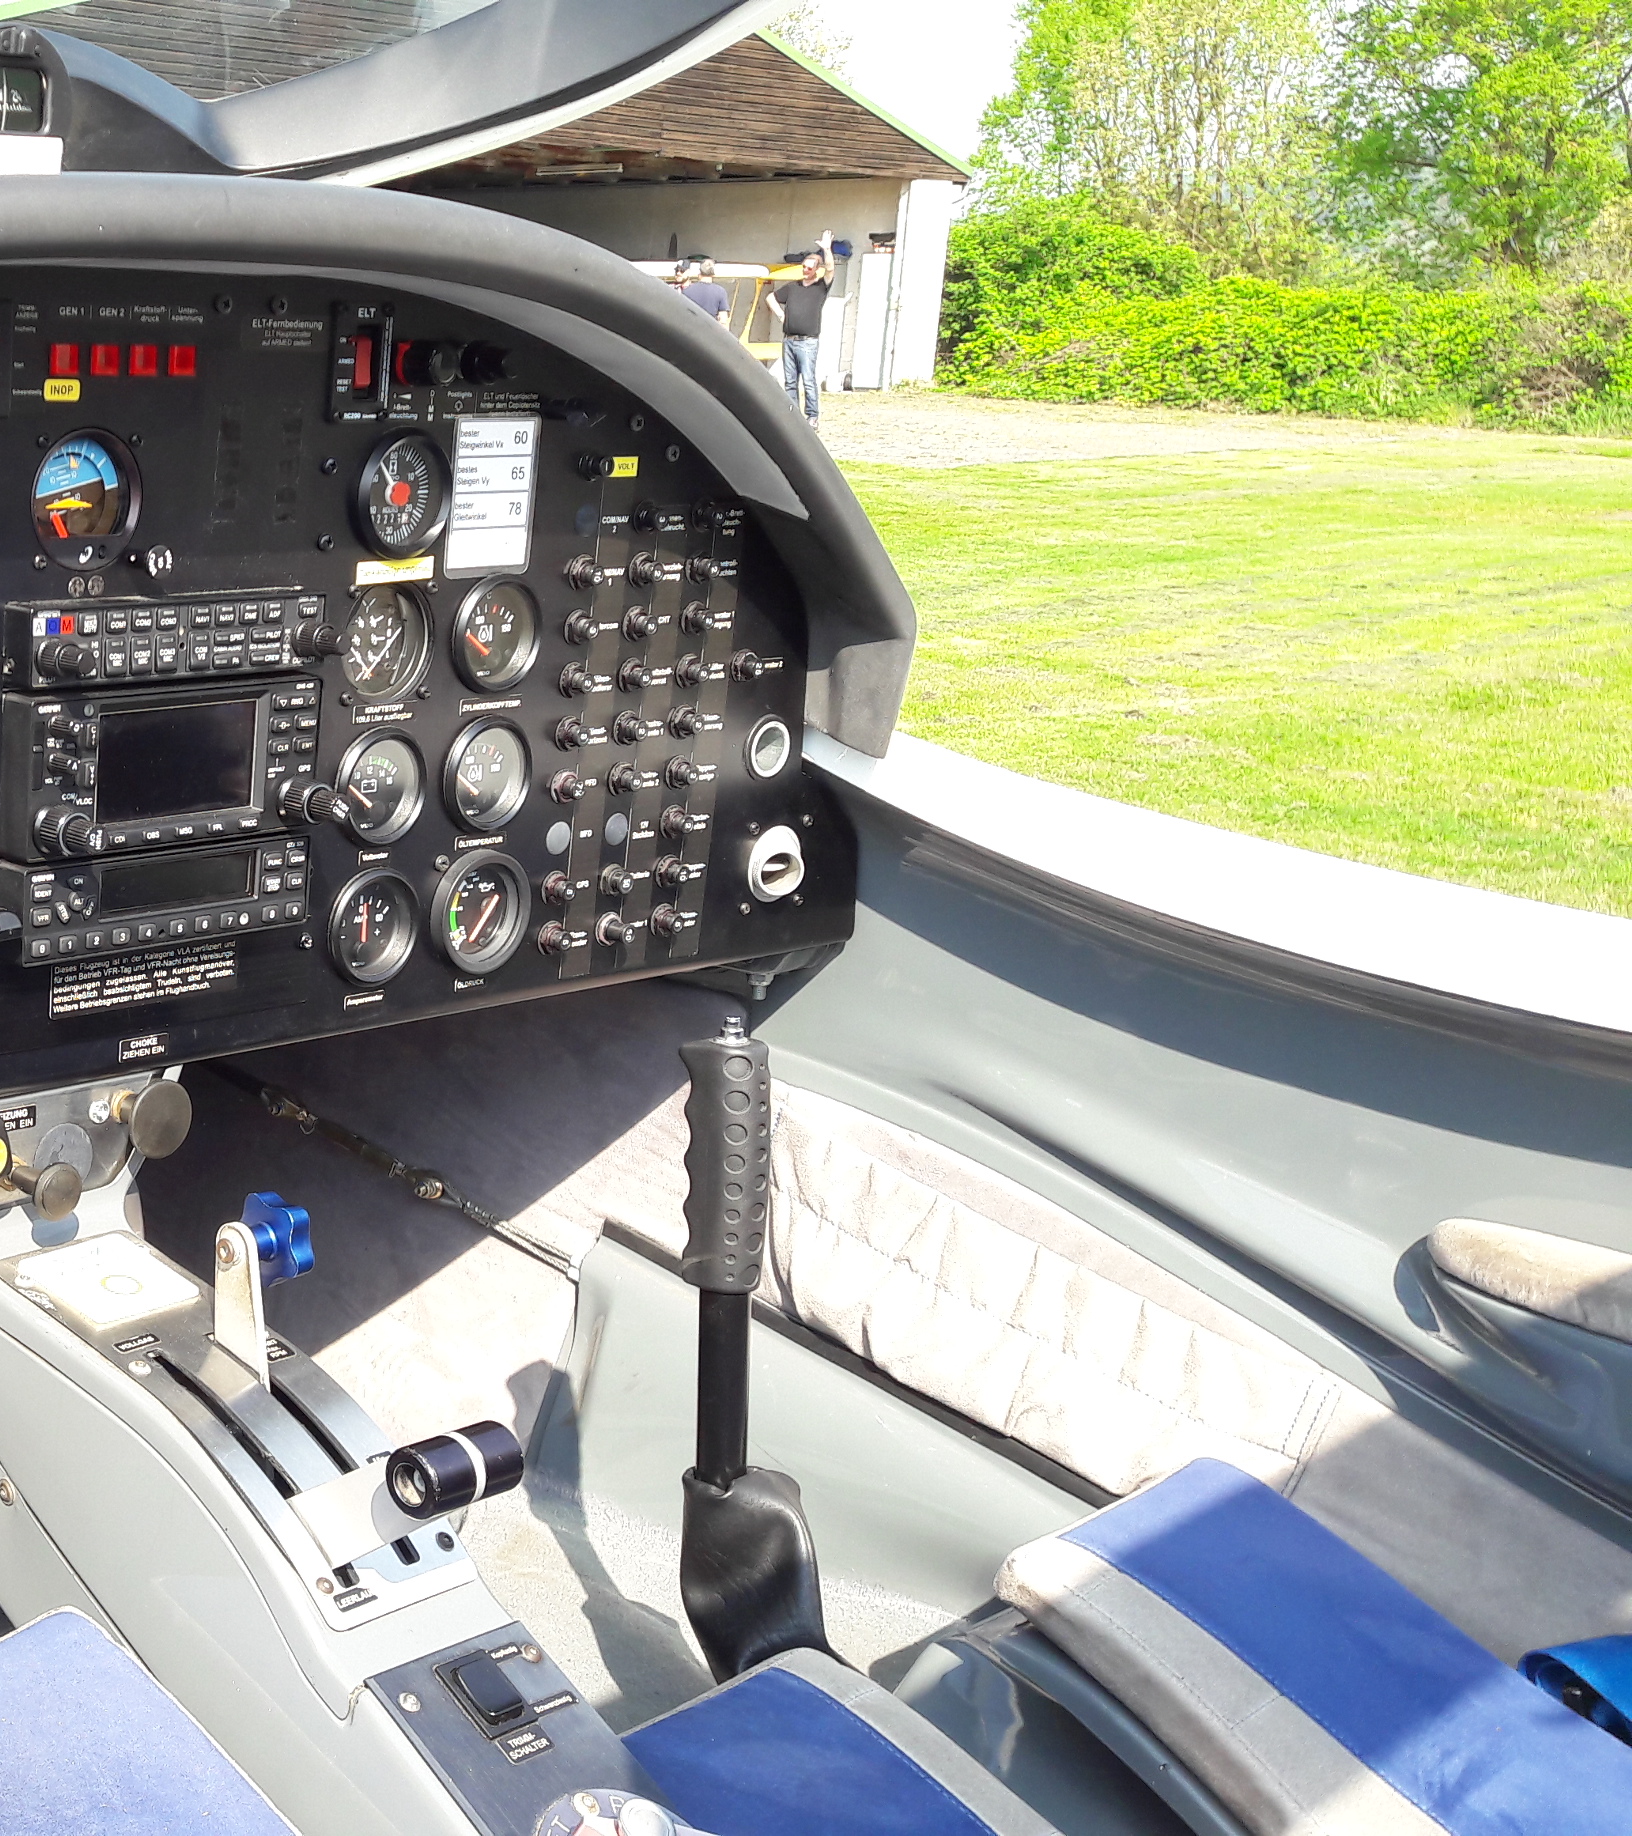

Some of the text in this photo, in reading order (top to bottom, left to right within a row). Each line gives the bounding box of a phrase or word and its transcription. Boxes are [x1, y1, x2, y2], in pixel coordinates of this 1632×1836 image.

[59, 306, 77, 316] GEN
[99, 307, 125, 317] GEN 2
[358, 307, 377, 318] ELT
[252, 319, 323, 330] ELT-Fernbedienung
[50, 385, 74, 396] INOP
[514, 430, 528, 445] 60
[459, 441, 494, 451] Steigwinkel
[511, 466, 525, 480] 65
[509, 502, 522, 515] 78
[146, 830, 160, 840] OBS
[178, 826, 193, 836] MSG
[64, 973, 77, 983] den
[78, 970, 102, 980] Betrieb
[103, 965, 132, 976] VFR-Tag
[147, 958, 182, 970] VFR-Nacht
[79, 960, 110, 972] Flugzeug
[53, 981, 100, 994] bedingungen
[53, 1003, 78, 1013] Weitere
[79, 995, 132, 1009] Betriebsgrenzen
[130, 1037, 158, 1049] CHOKE
[122, 1045, 165, 1060] ZIEHEN EIN
[19, 1118, 34, 1128] EIN
[509, 1737, 550, 1760] SCHALTER
